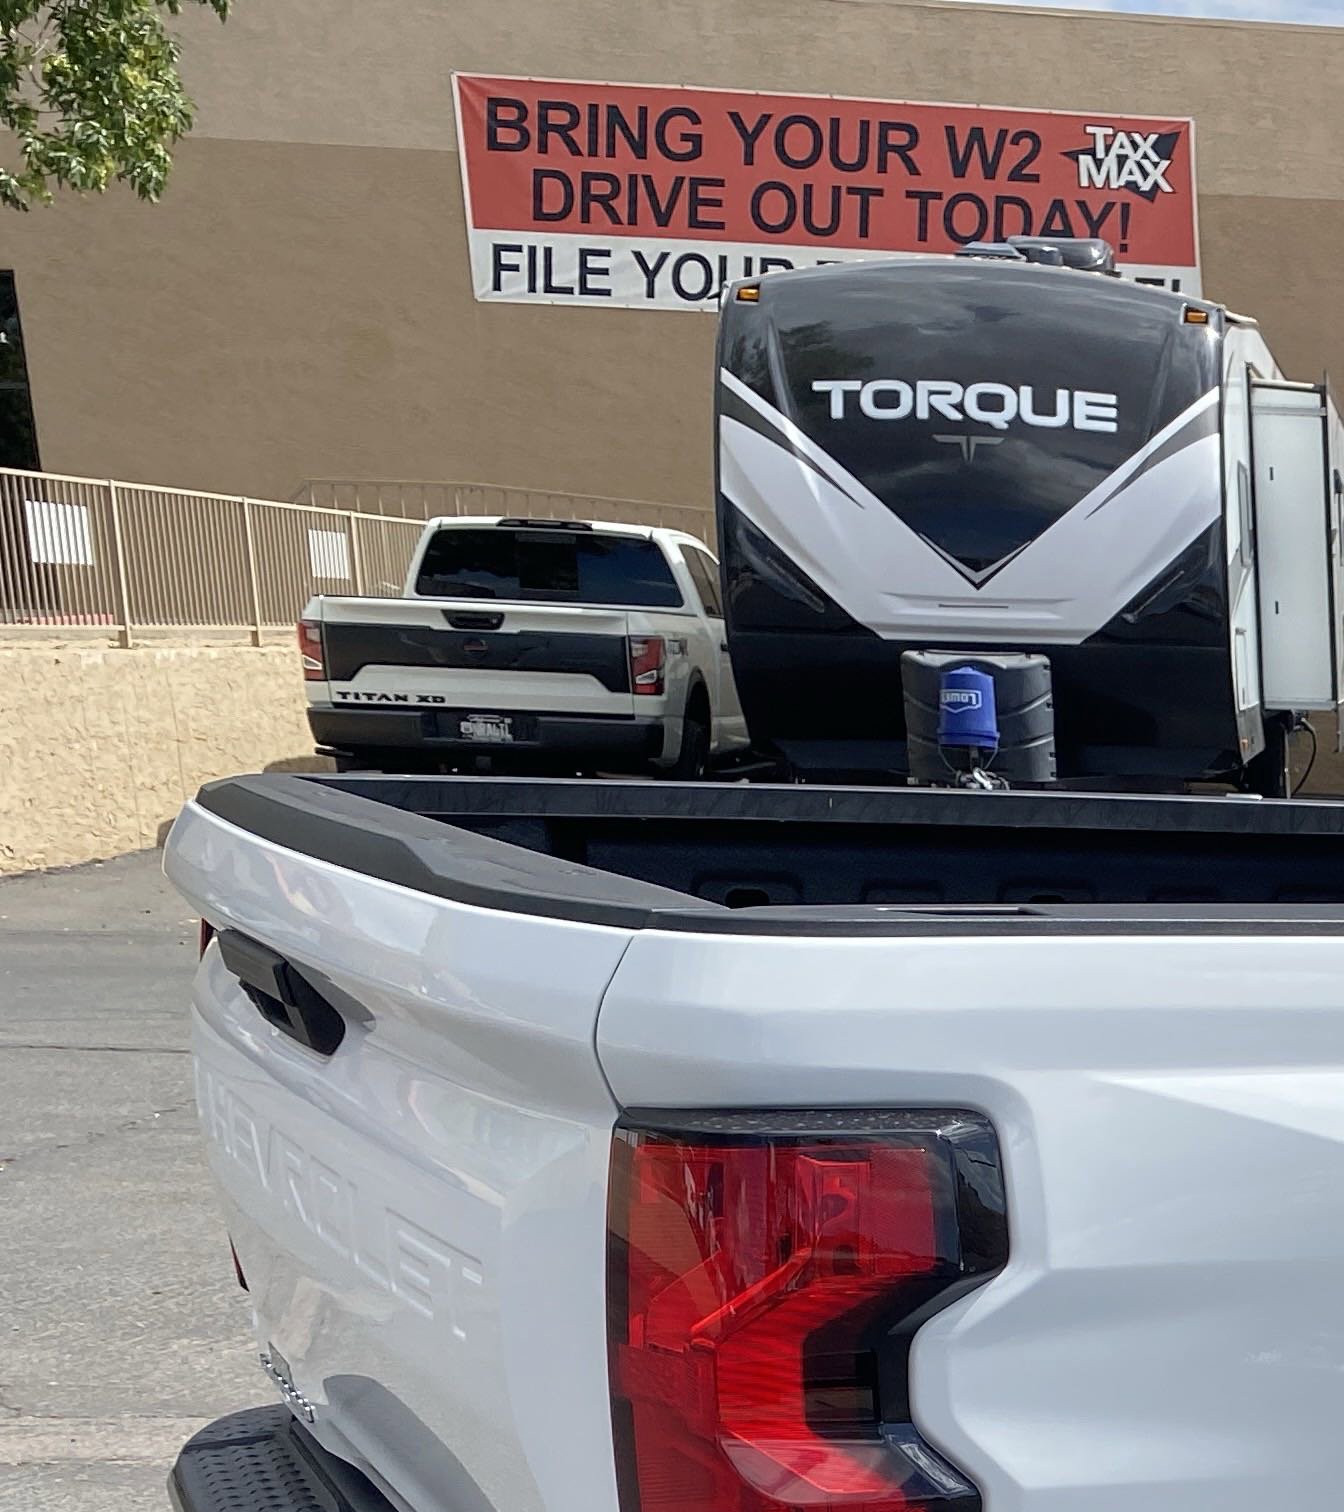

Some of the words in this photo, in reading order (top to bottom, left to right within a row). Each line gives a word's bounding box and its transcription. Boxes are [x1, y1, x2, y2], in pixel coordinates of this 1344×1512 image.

[485, 97, 703, 163] BRING
[729, 111, 921, 177] YOUR
[945, 125, 1042, 184] W2
[1084, 124, 1163, 161] TAX
[1078, 152, 1175, 194] MAX
[532, 168, 727, 231] DRIVE
[750, 182, 883, 239] OUT
[907, 190, 1132, 254] TODAY!
[492, 243, 613, 298] FILE
[812, 379, 1118, 433] TORQUE
[336, 691, 409, 702] TITAN
[416, 694, 446, 704] XD
